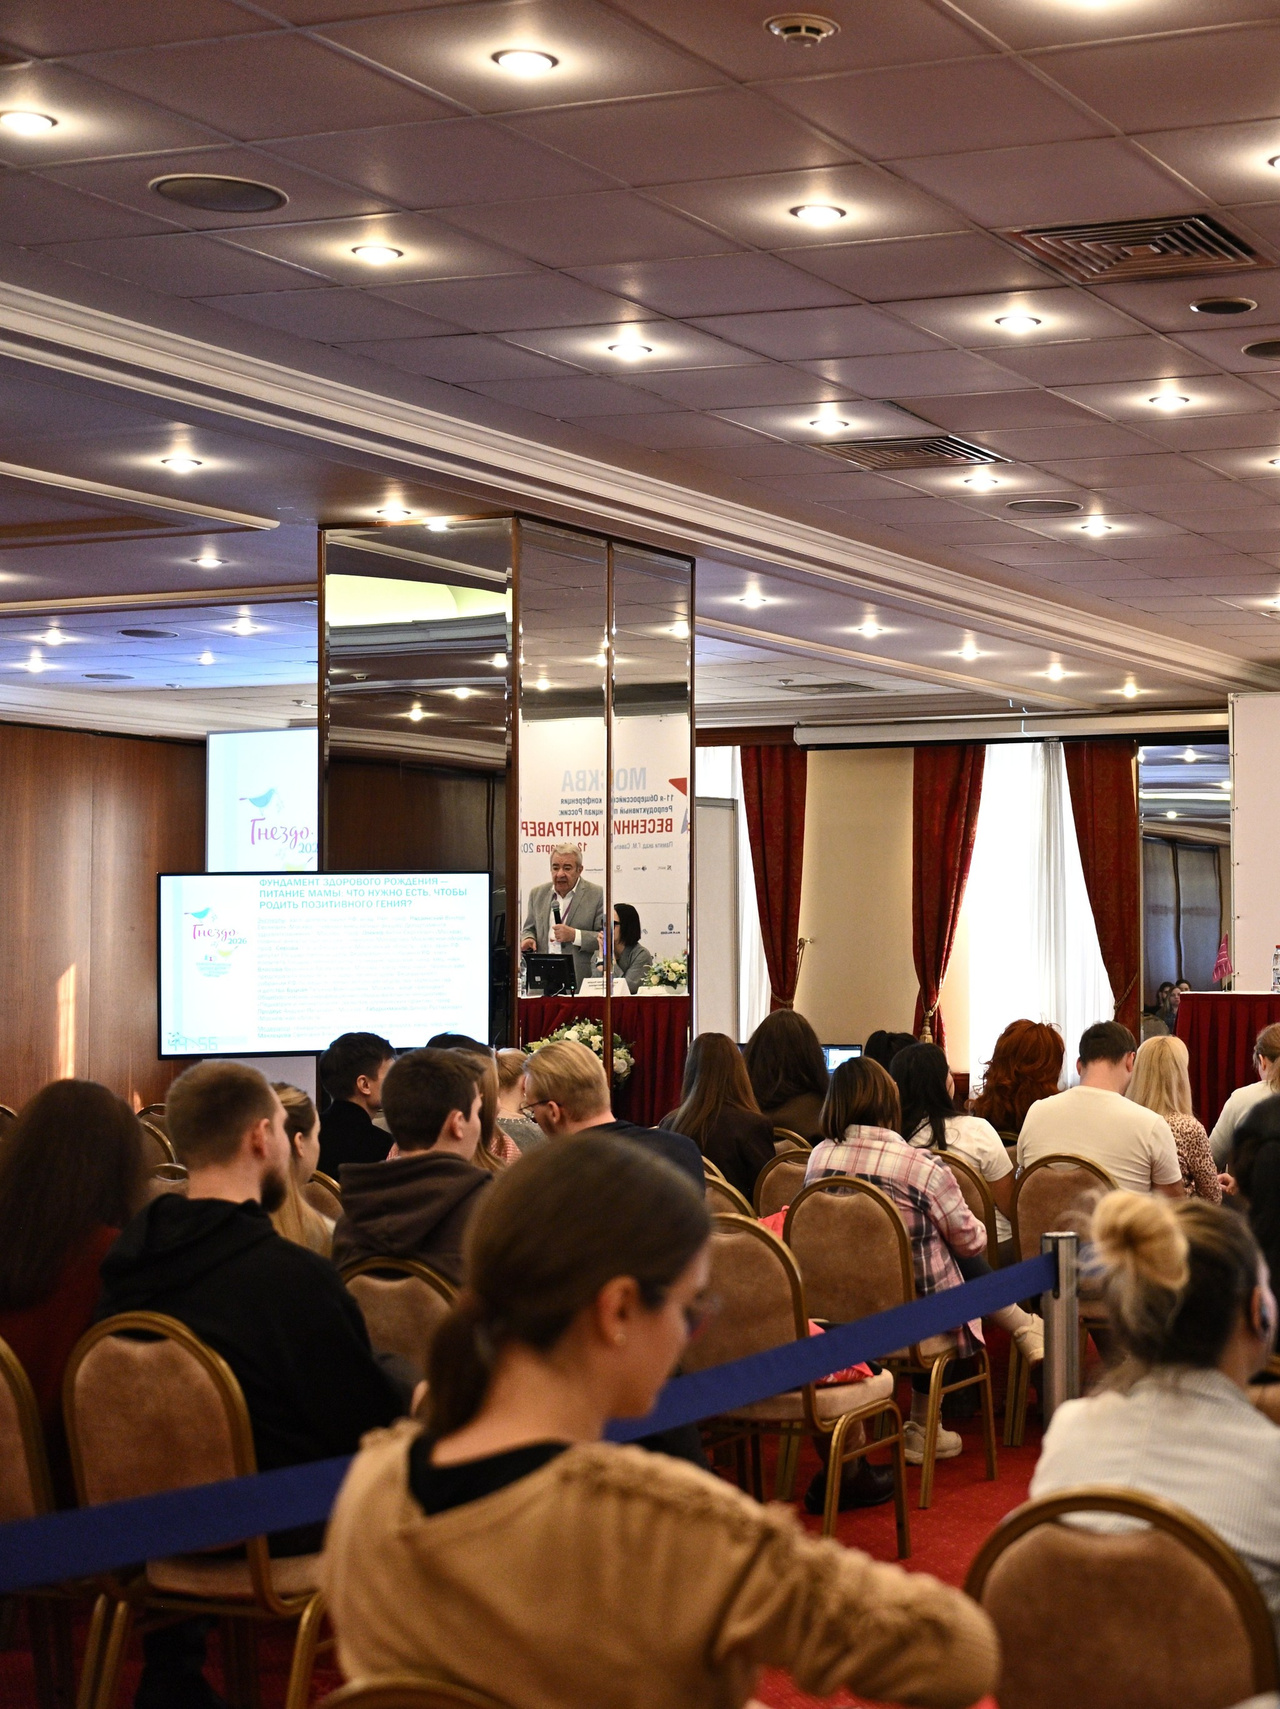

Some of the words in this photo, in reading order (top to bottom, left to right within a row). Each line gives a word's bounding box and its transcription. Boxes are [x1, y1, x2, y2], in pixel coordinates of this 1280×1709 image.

[259, 878, 320, 888] ФУНДАМЕНТ
[323, 878, 381, 887] ЗДОРОВОГО
[384, 877, 438, 886] РОЖДЕНИЯ
[259, 889, 306, 898] ПИТАНИЕ
[346, 889, 365, 897] ЧТО
[368, 888, 403, 897] НУЖНО
[433, 888, 468, 896] ЧТОБЫ
[259, 900, 299, 910] РОДИТЬ
[301, 900, 373, 909] ПОЗИТИВНОГО
[376, 899, 412, 909] ГЕНИЯ?
[227, 937, 247, 945] 2026
